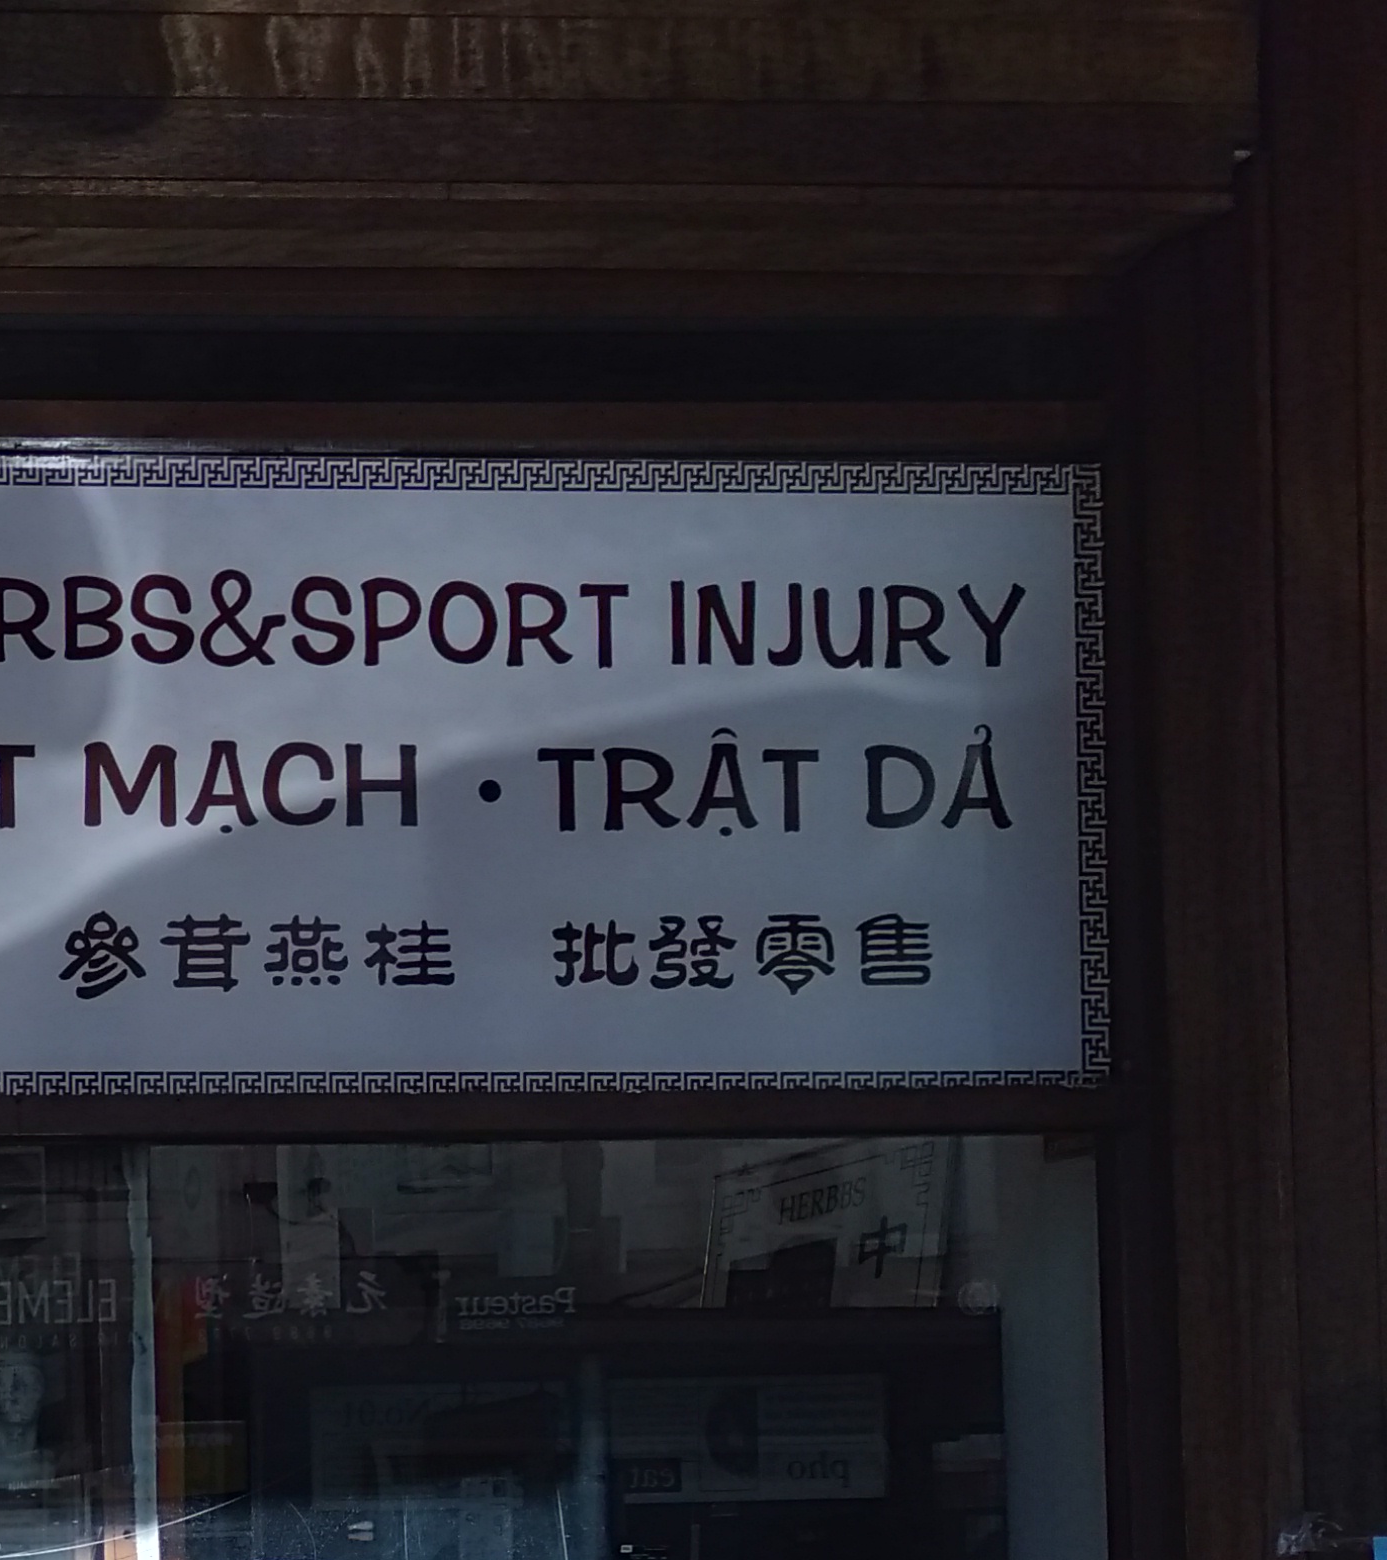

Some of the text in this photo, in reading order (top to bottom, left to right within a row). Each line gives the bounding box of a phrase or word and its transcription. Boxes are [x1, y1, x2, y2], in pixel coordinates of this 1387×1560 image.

[670, 579, 1027, 670] INJURY
[83, 740, 418, 834] MẠCH
[537, 727, 819, 838] TRẬT
[864, 724, 1013, 830] DẢ
[59, 911, 456, 999] 參茸燕桂
[553, 912, 933, 996] 批發零售
